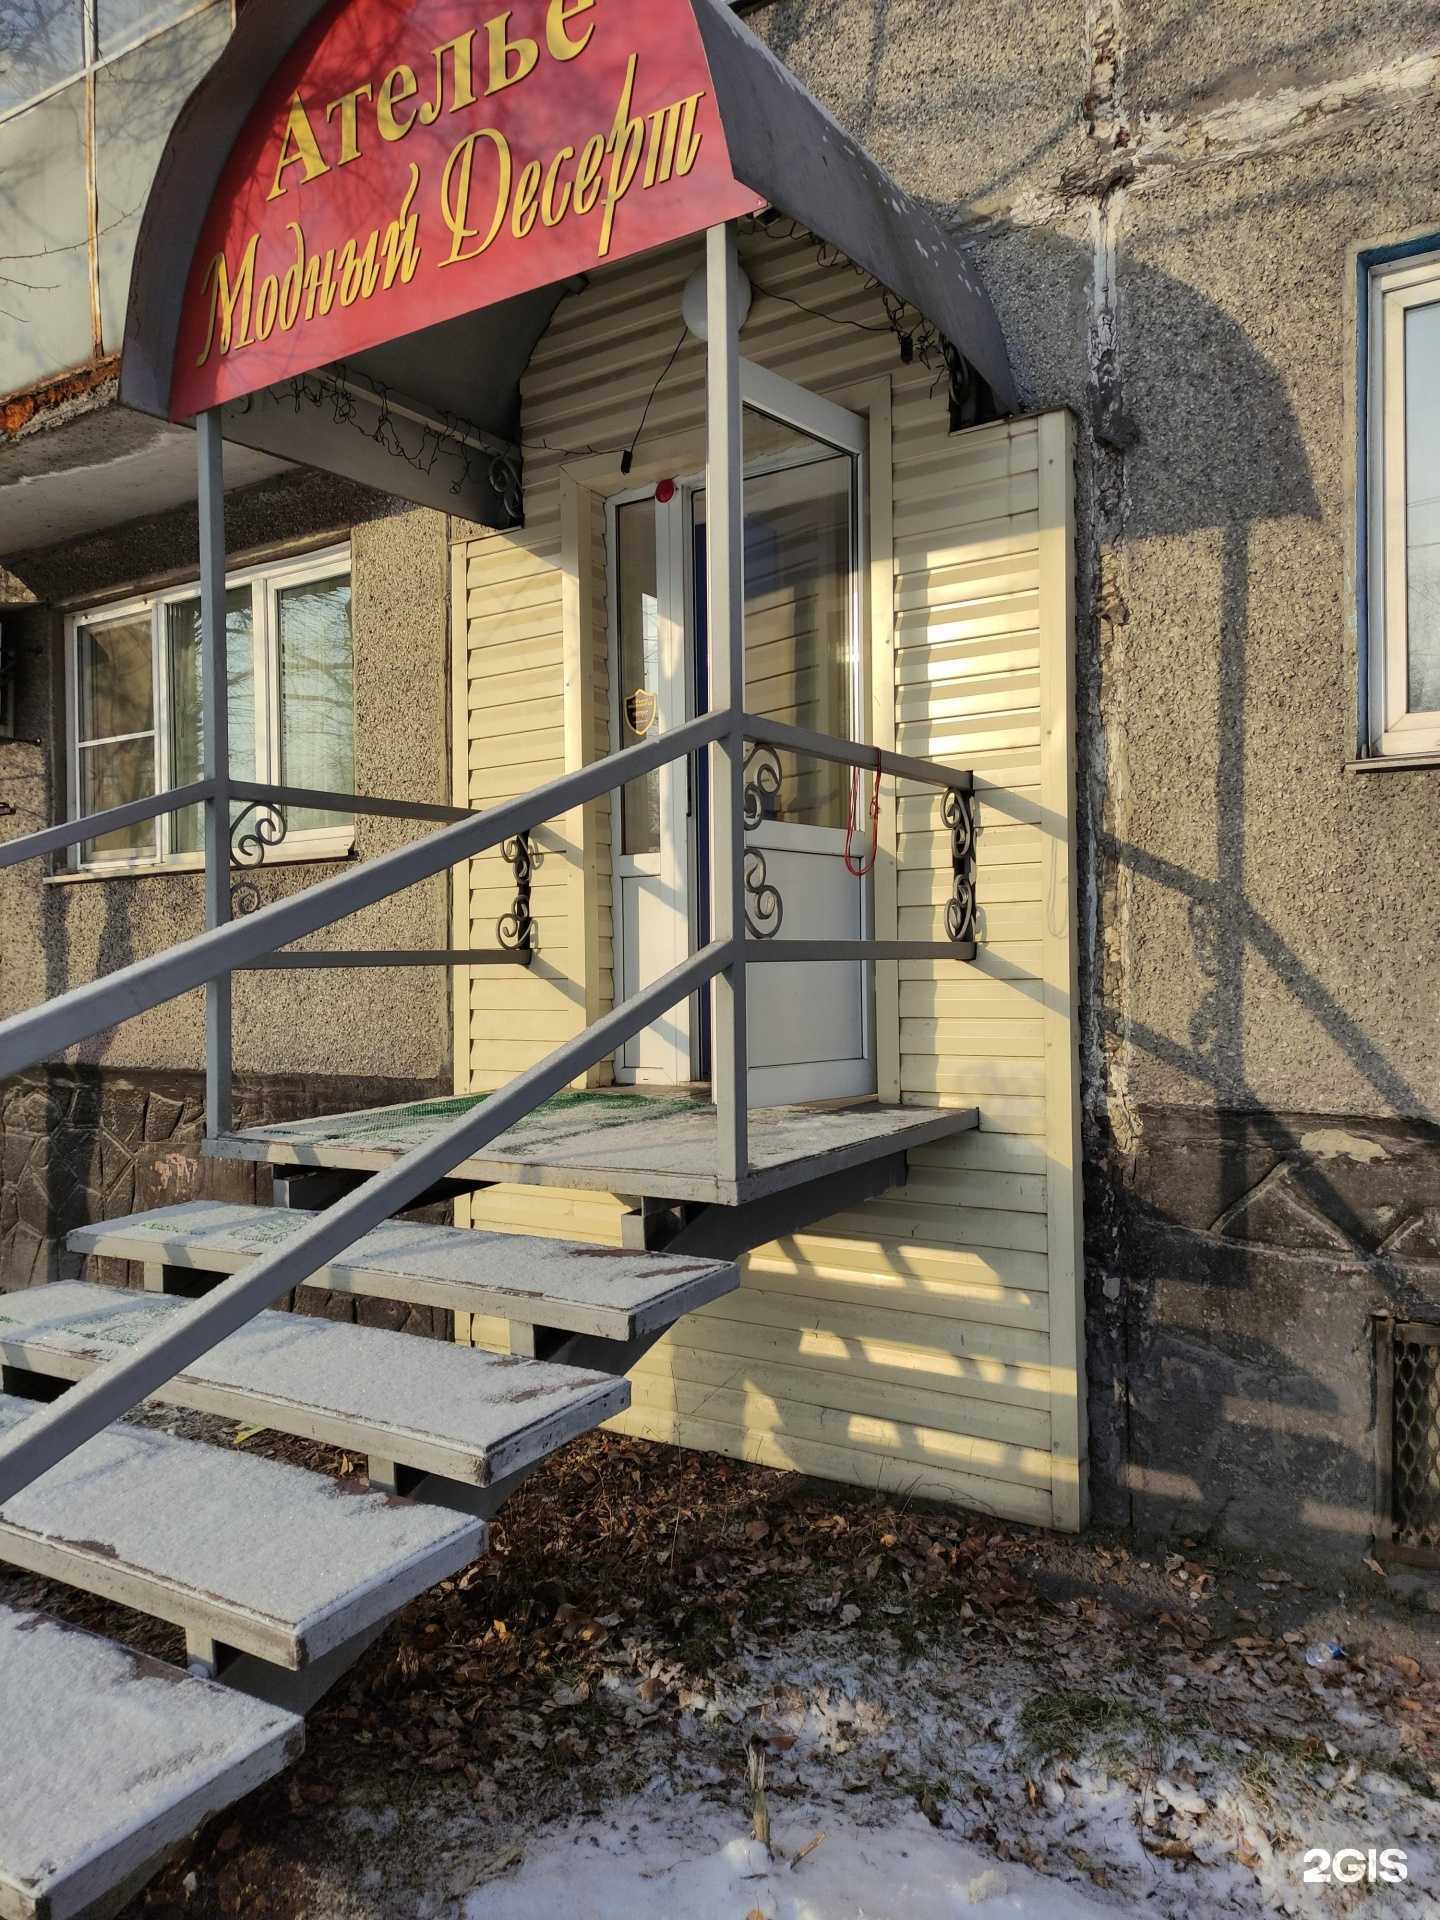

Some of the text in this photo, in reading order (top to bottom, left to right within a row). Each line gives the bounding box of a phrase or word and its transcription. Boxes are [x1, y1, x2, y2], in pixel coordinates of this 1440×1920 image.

[196, 52, 706, 367] Модный Десерт
[266, 0, 596, 202] Ателье
